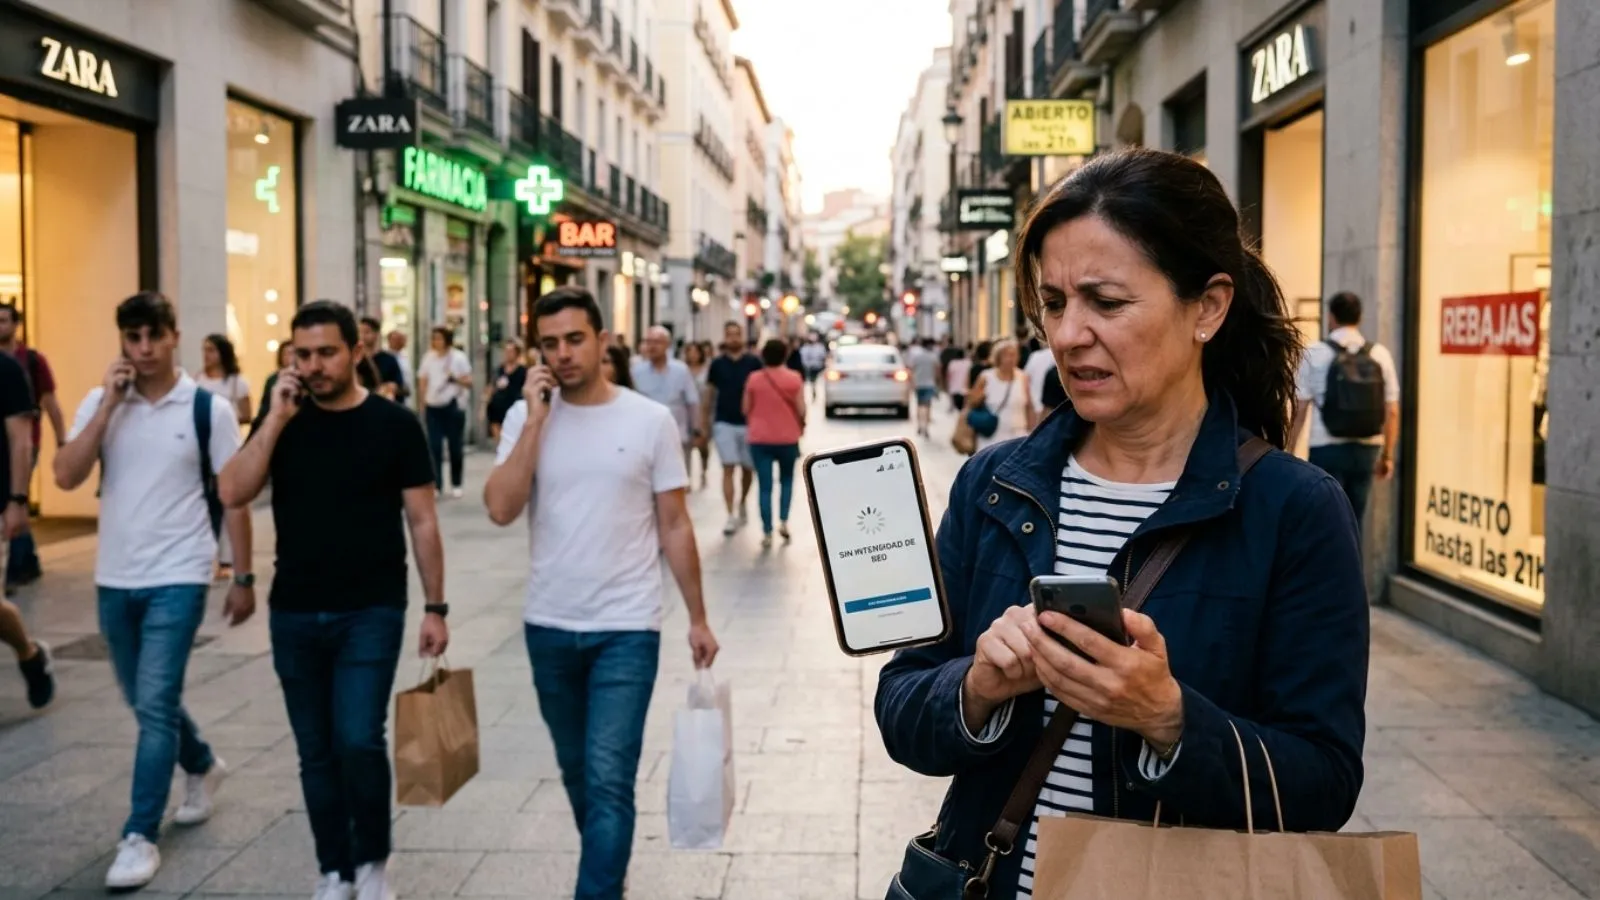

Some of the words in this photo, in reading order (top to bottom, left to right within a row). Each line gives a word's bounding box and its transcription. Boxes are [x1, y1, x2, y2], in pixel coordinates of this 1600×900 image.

[41, 36, 118, 98] ZARA
[1251, 23, 1310, 104] ZARA
[347, 114, 412, 134] ZARA
[1012, 105, 1089, 120] ABIERTO
[404, 146, 488, 213] FARMACIA
[560, 221, 615, 247] BAR
[1443, 301, 1537, 347] REBAJAS
[1426, 485, 1511, 536] ABIERTO
[1425, 520, 1473, 566] hasta
[1479, 537, 1507, 578] las
